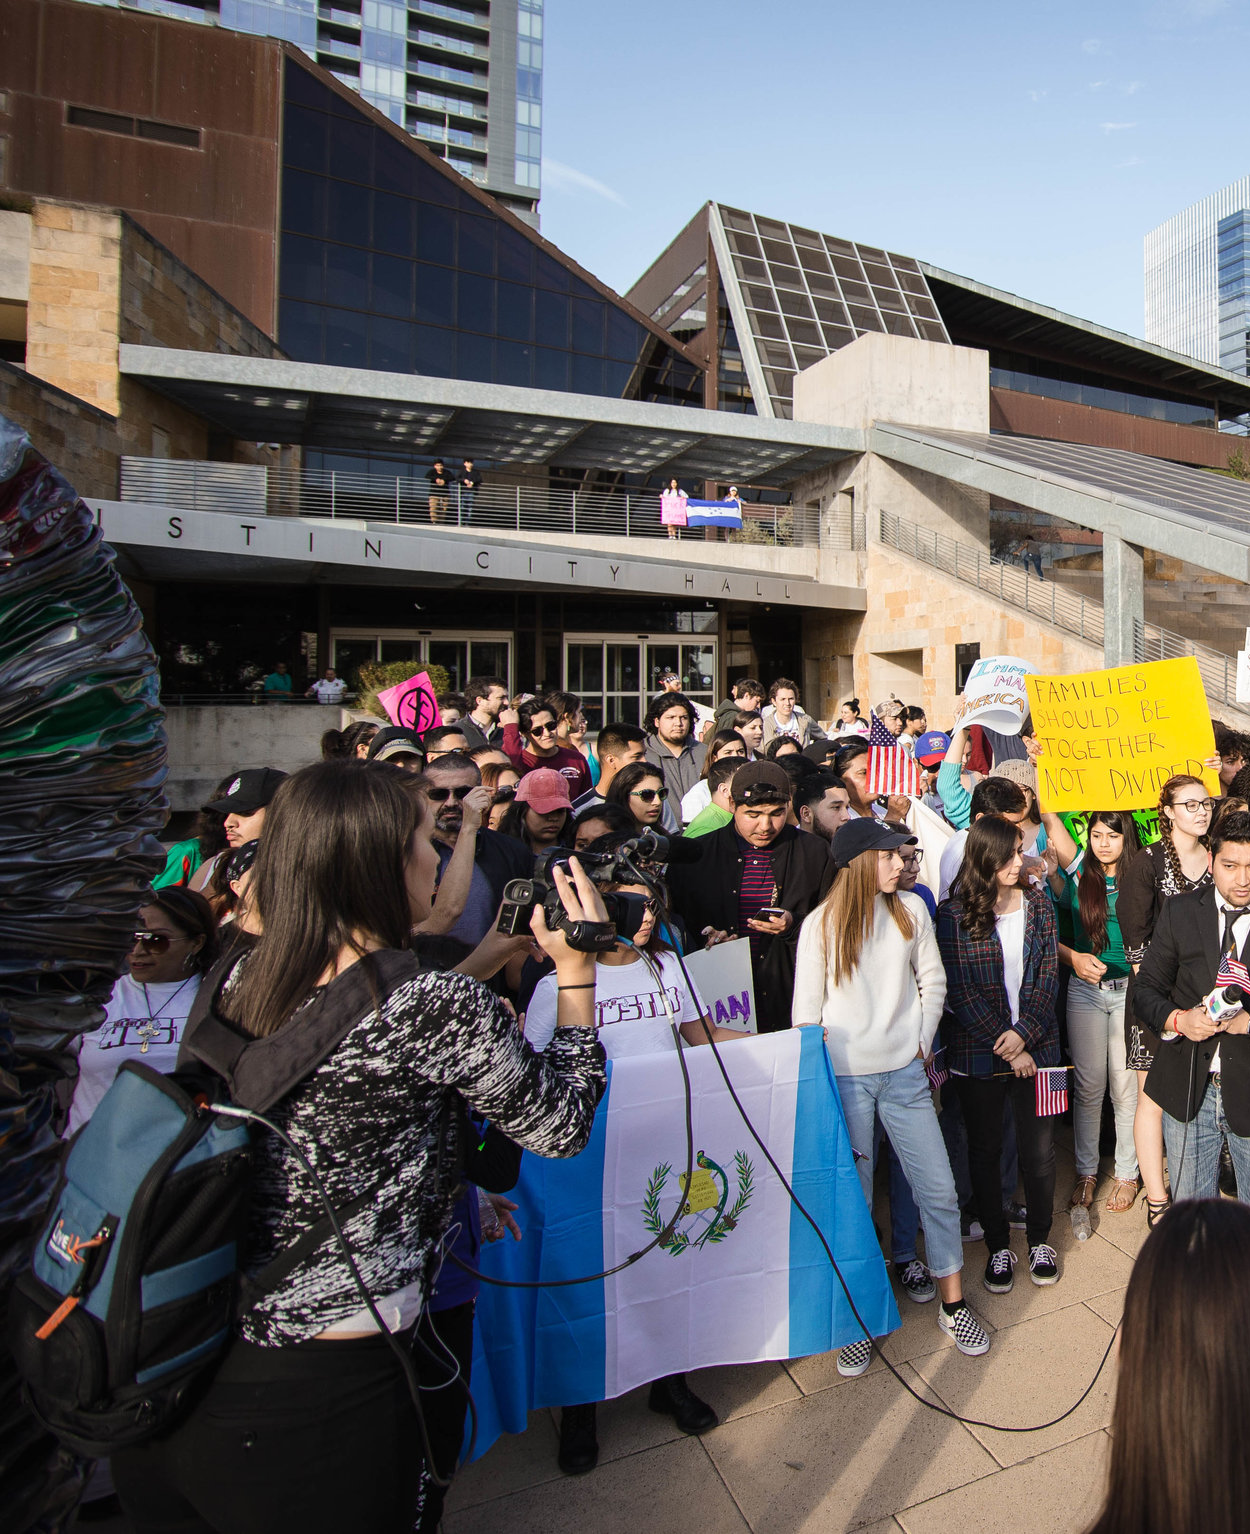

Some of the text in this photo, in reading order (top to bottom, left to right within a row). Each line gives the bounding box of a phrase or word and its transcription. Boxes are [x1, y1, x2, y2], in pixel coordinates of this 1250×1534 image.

[97, 508, 791, 599] STIN CITY HALL
[970, 659, 1032, 680] IMM
[1034, 672, 1147, 703] FAMILIES
[1037, 698, 1171, 730] SHOULD BE
[1041, 732, 1165, 760] TOGETHER
[1045, 768, 1087, 801] NOT
[707, 991, 750, 1024] AN
